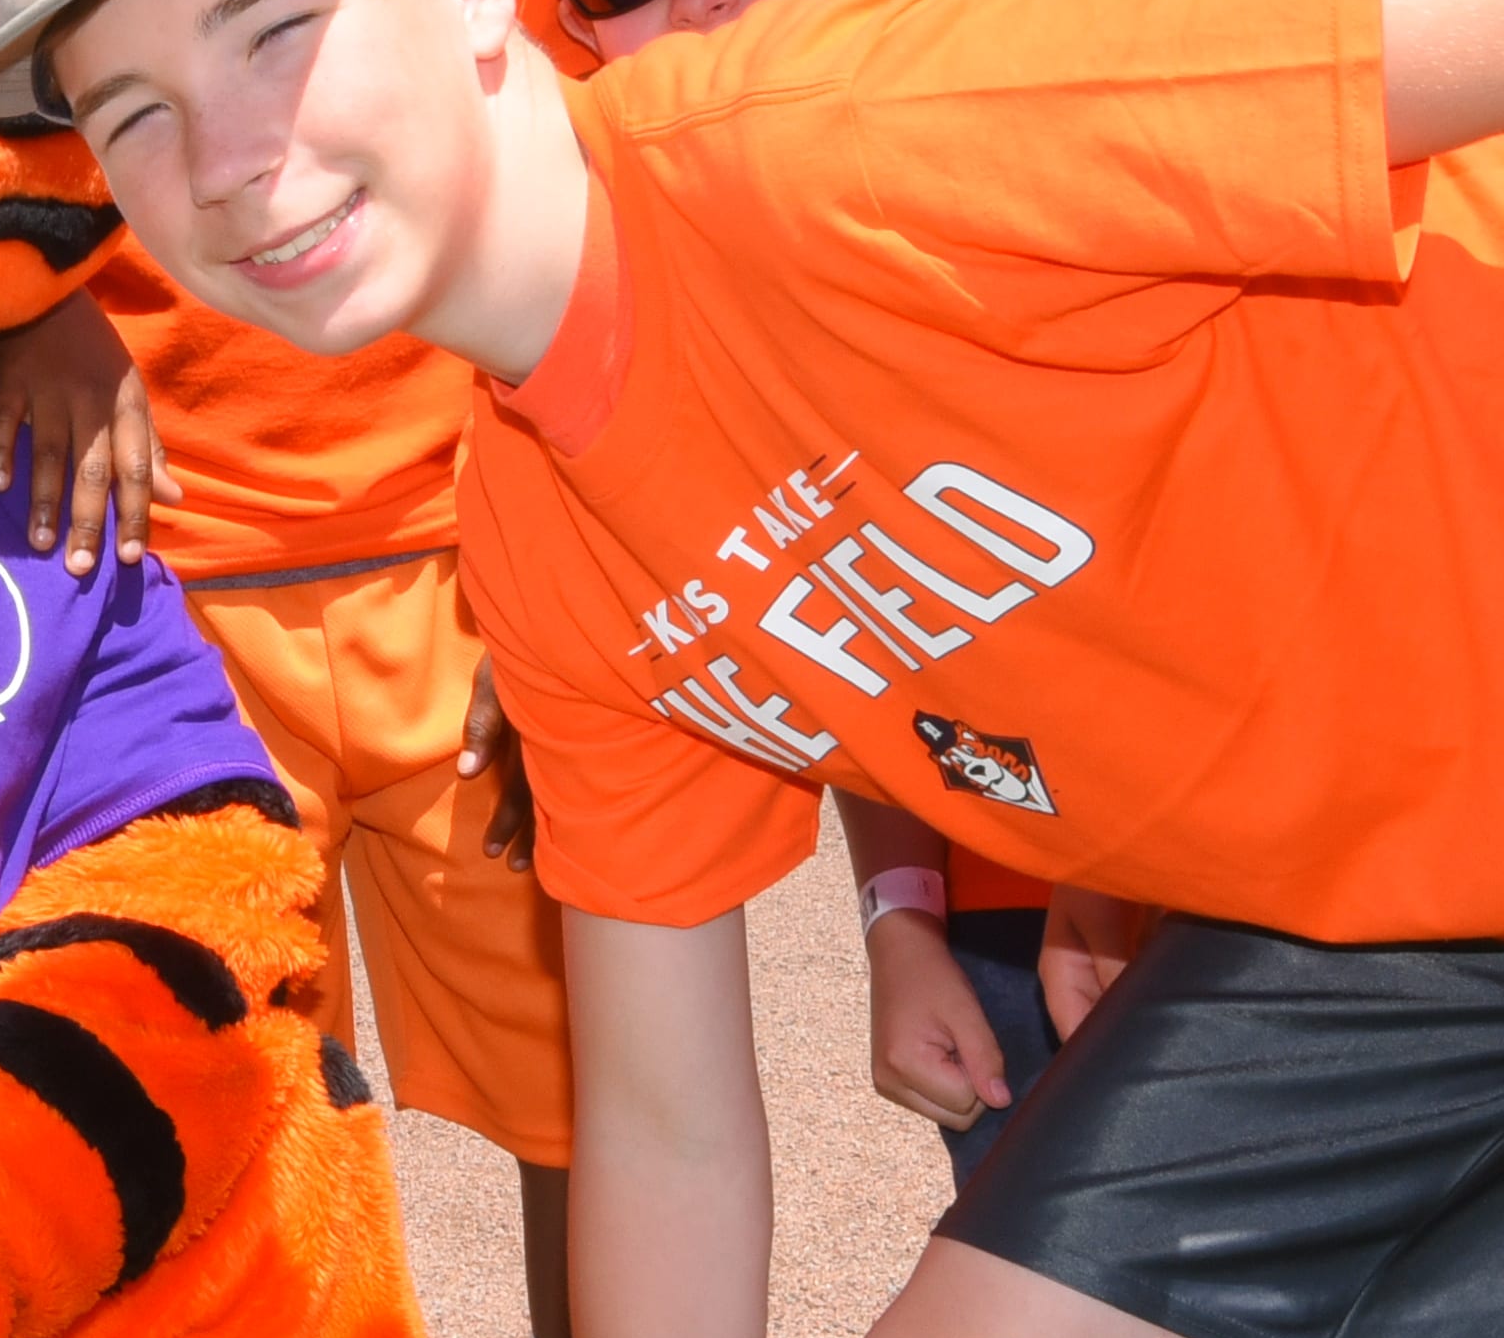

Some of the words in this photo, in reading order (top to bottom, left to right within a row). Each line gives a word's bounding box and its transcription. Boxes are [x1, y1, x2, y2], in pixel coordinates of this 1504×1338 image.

[649, 653, 840, 773] HE
[757, 461, 1096, 699] FIELD
[715, 468, 836, 572] TAKE
